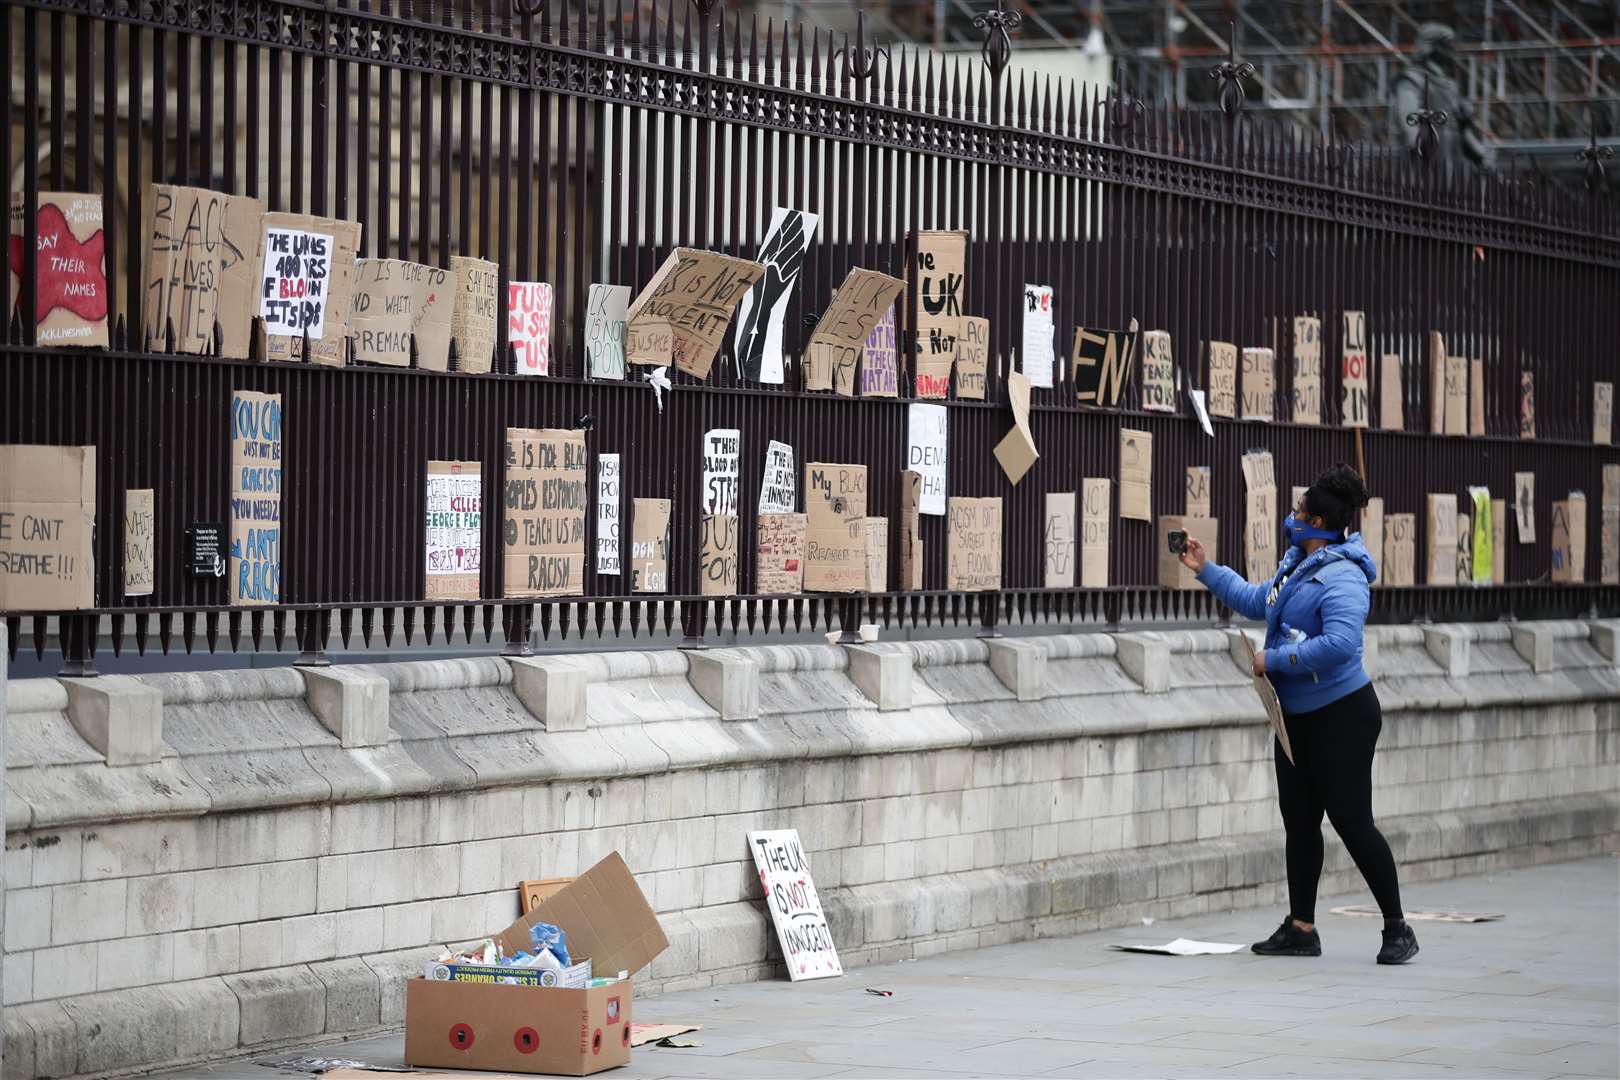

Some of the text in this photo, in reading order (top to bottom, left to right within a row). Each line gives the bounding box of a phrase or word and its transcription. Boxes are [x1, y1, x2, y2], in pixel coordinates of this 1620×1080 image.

[268, 233, 289, 253] THE
[51, 257, 86, 273] THEIR
[374, 261, 392, 281] IS
[428, 269, 445, 285] TO
[64, 283, 97, 297] NAMES
[922, 273, 963, 319] UK
[232, 396, 260, 441] YOU
[271, 442, 281, 461] BE
[241, 467, 281, 493] RACIST
[812, 470, 832, 500] My
[232, 498, 252, 520] YOU
[833, 497, 842, 514] is
[0, 512, 15, 541] E
[523, 517, 552, 545] TEACH
[556, 517, 569, 544] US
[757, 838, 812, 873] THE UK
[785, 880, 811, 911] NOT
